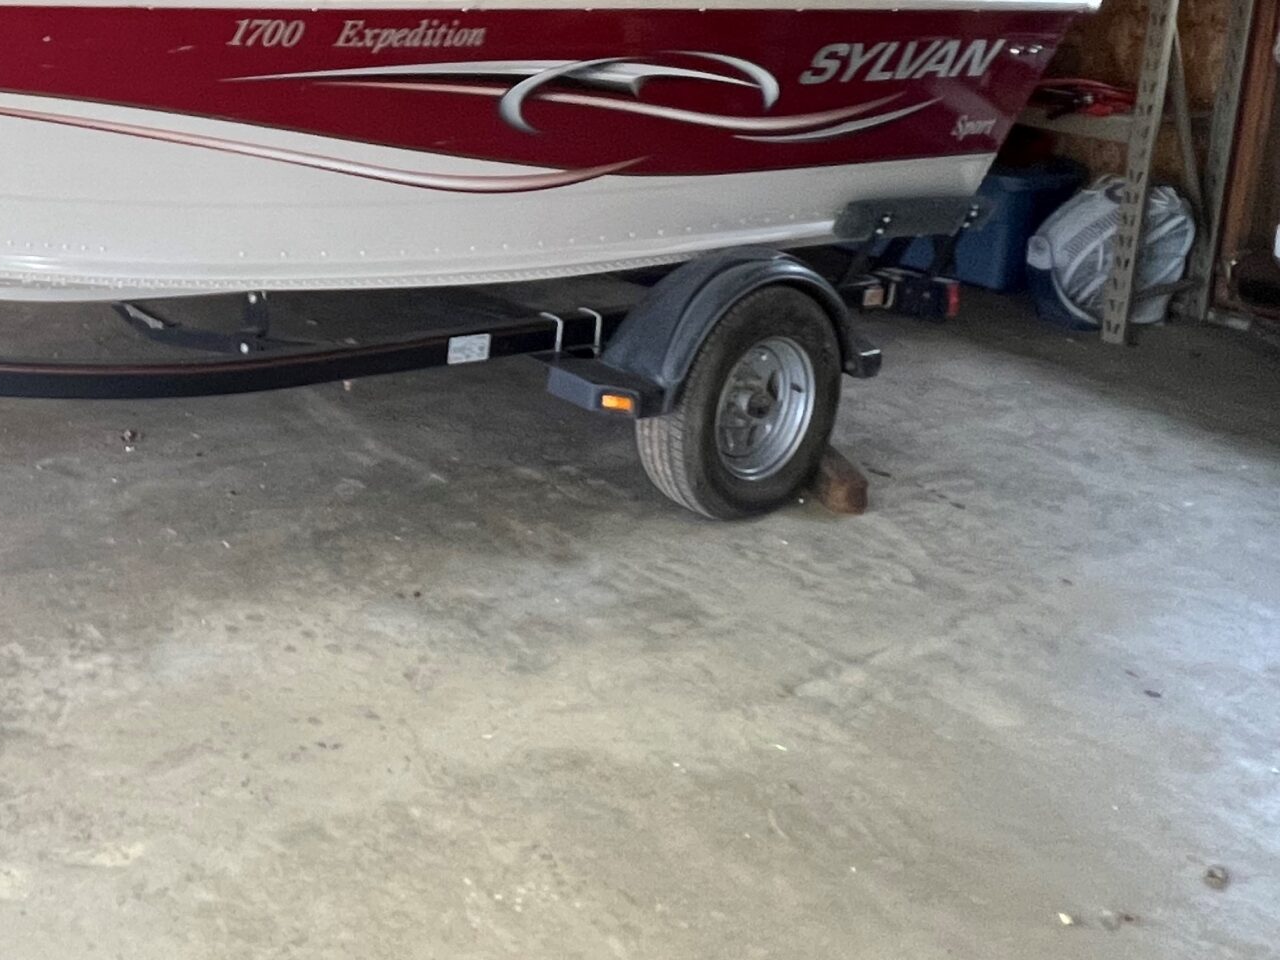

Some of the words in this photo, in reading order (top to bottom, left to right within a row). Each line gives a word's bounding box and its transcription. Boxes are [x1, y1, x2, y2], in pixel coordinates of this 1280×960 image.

[225, 19, 305, 48] 1700
[332, 18, 487, 54] Expedition
[798, 38, 1008, 85] SYLVAN
